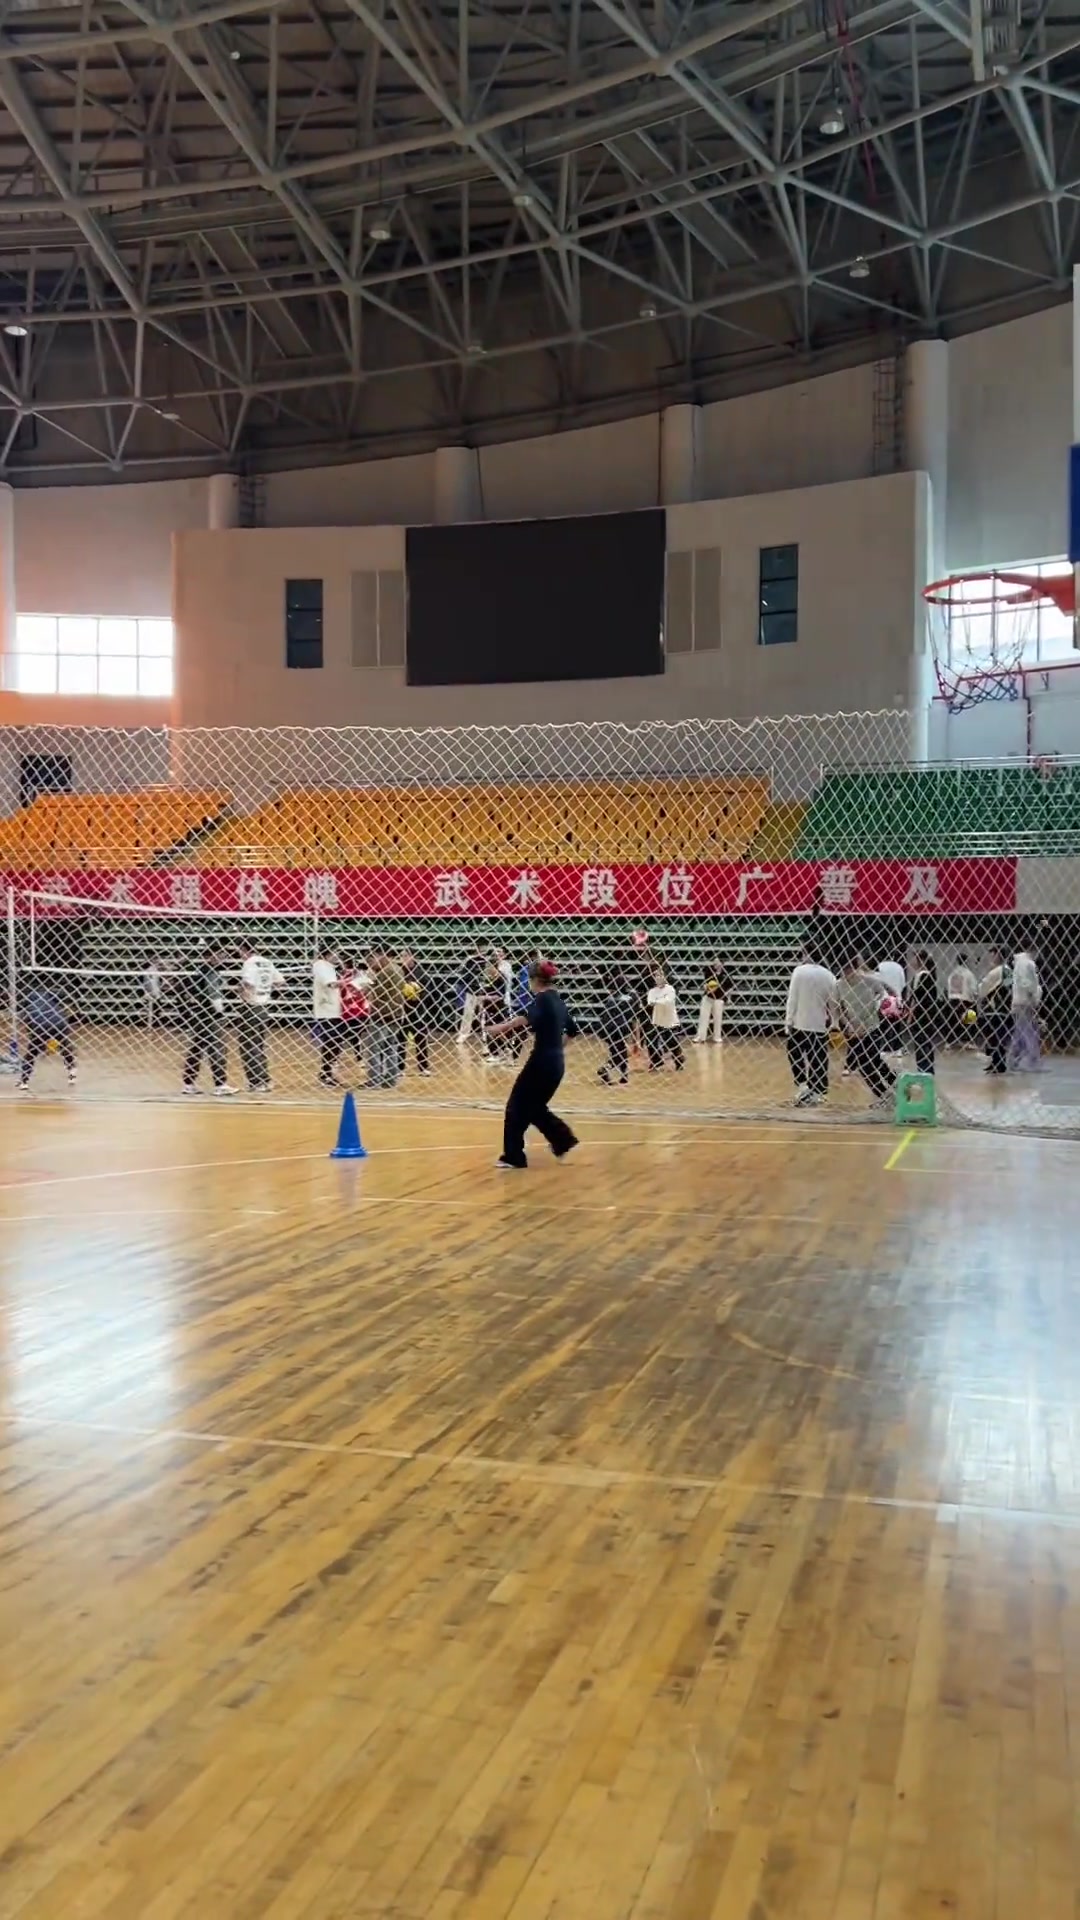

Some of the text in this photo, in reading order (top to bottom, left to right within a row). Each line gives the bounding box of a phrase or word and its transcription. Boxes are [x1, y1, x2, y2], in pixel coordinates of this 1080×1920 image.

[434, 866, 942, 911] 武术段位广普及
